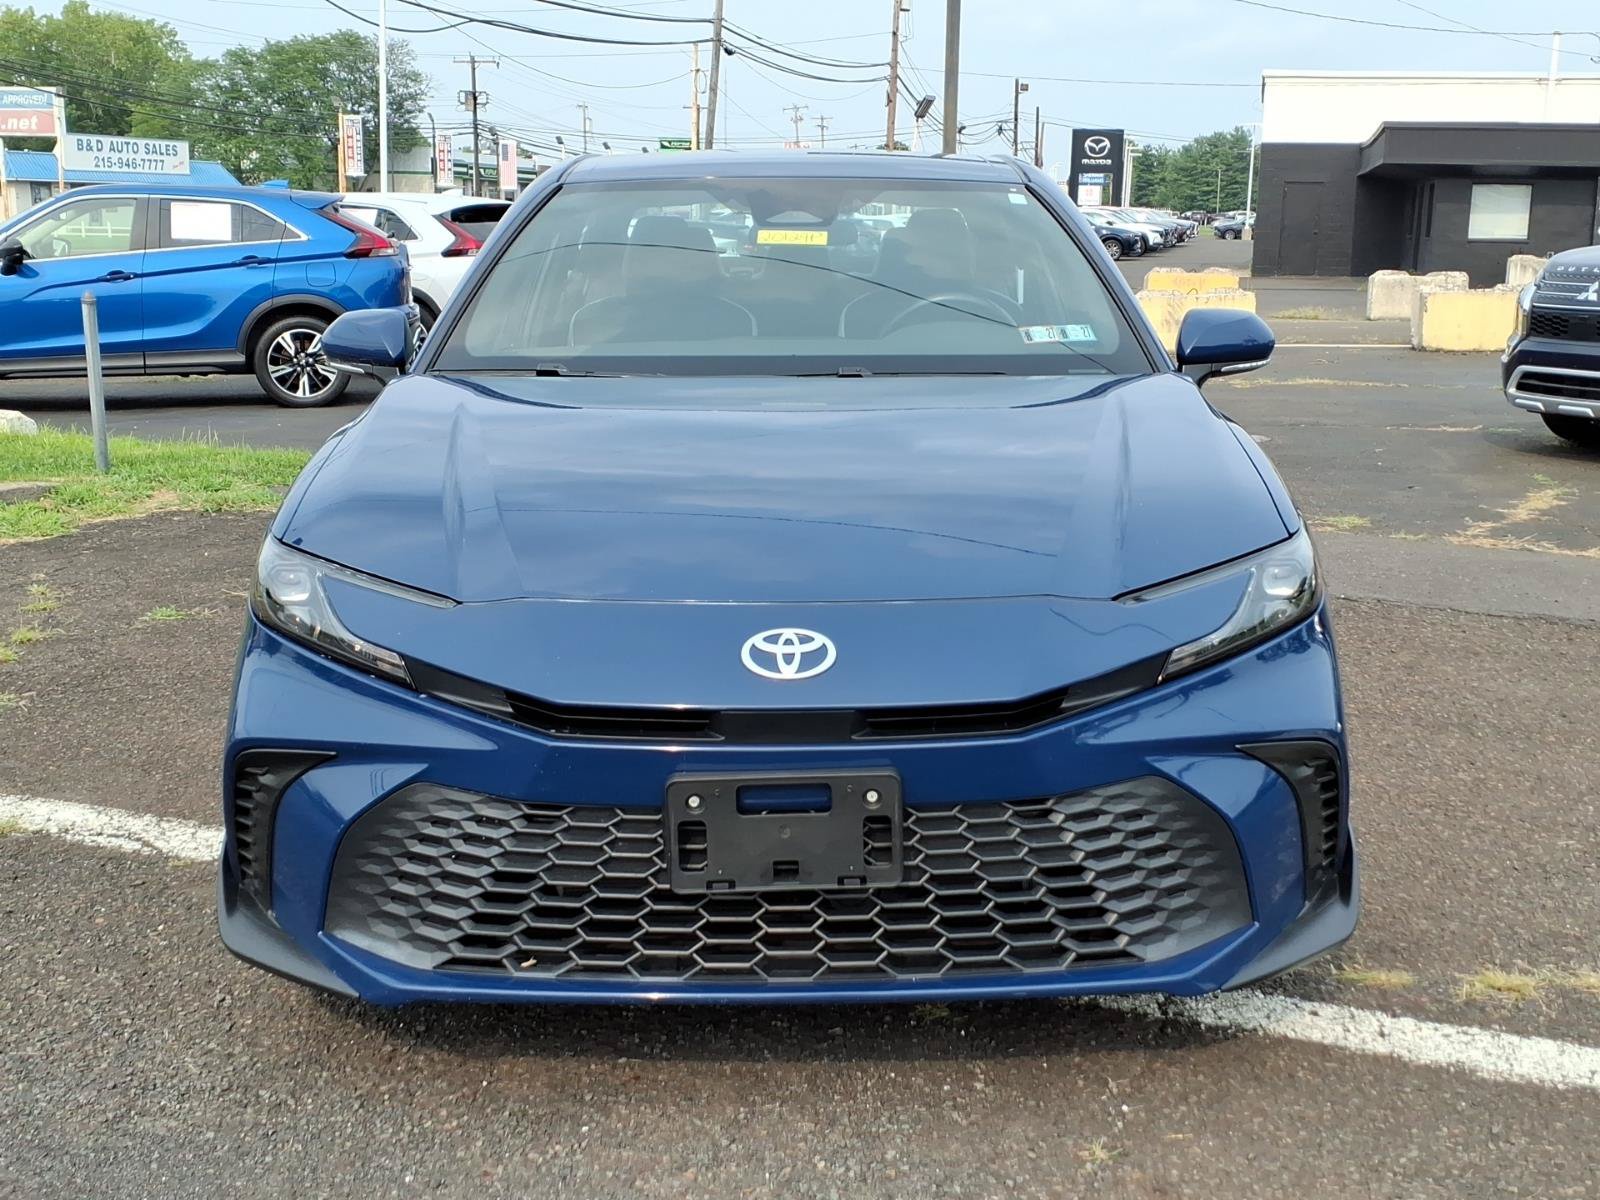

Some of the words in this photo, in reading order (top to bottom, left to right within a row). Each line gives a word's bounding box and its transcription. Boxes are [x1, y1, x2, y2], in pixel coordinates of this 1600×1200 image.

[76, 138, 104, 152] B&D
[109, 140, 140, 154] AUTO
[144, 142, 179, 157] SALES
